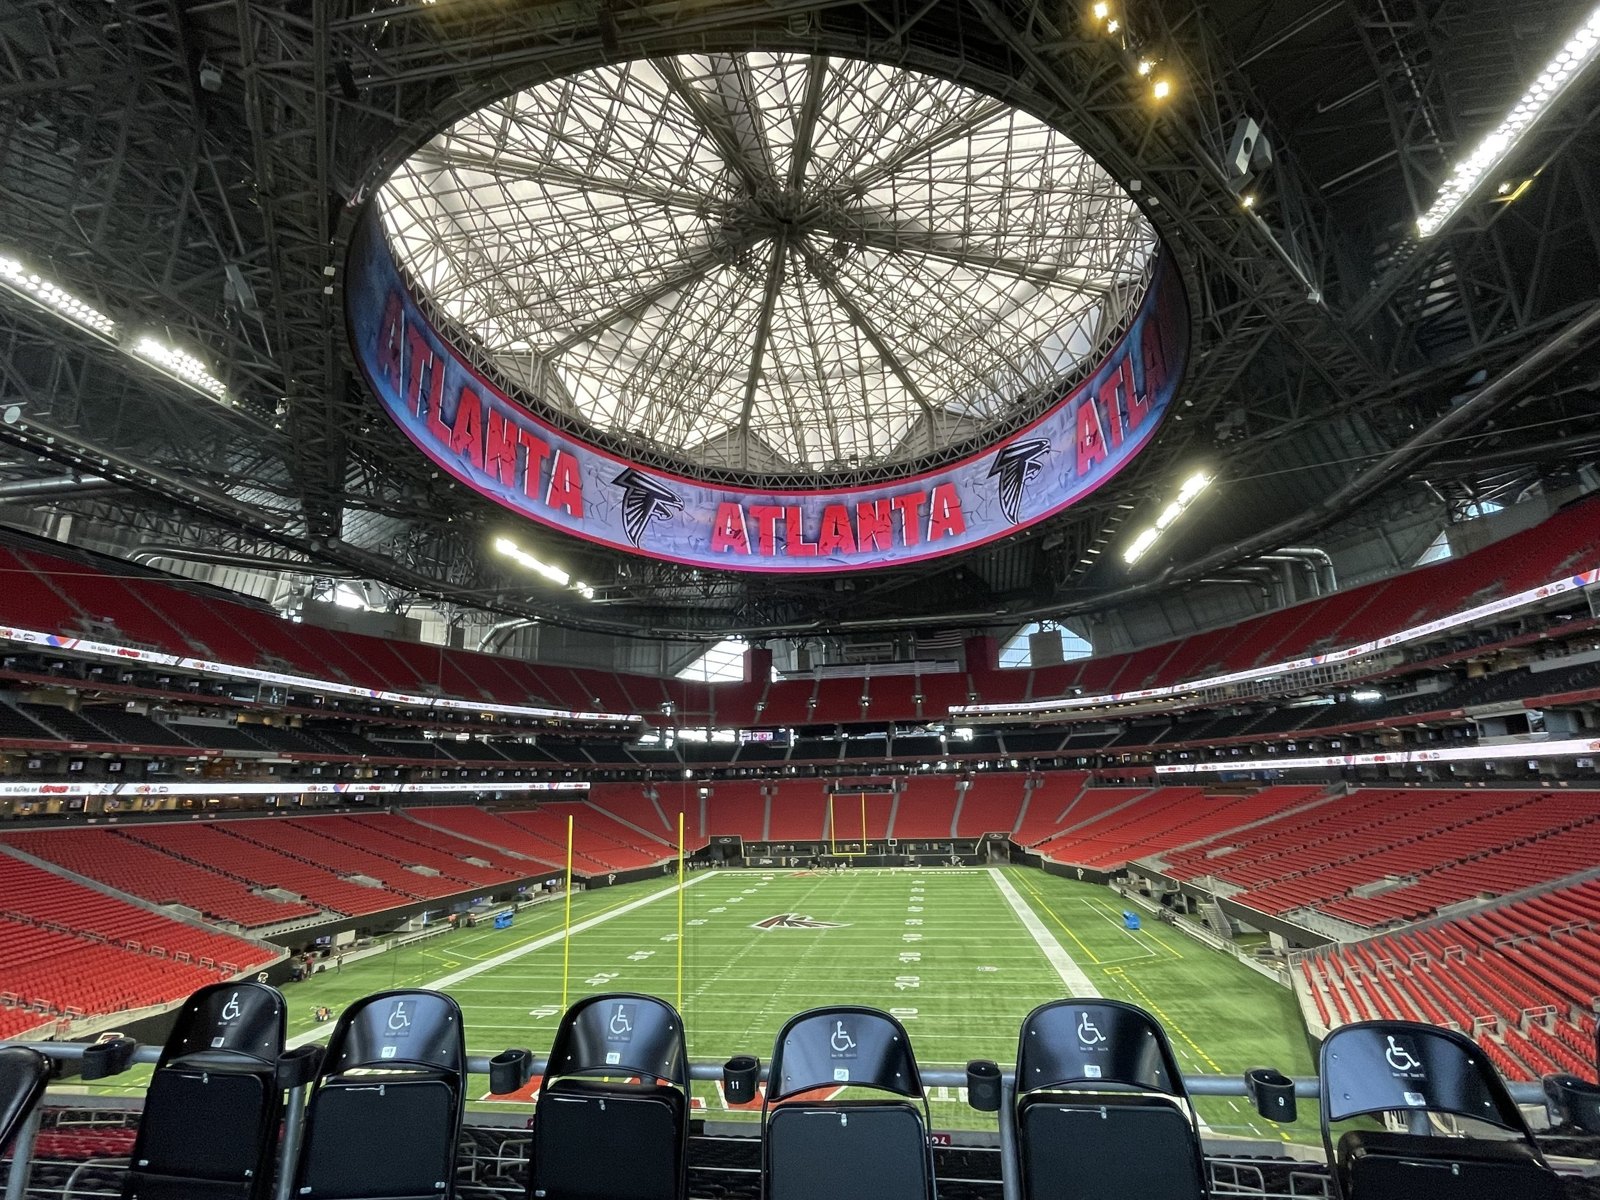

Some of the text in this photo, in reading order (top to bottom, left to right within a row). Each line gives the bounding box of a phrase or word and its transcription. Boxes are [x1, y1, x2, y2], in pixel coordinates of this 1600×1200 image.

[377, 288, 584, 519] ATLANTA
[710, 482, 967, 557] ATLANTA
[731, 1080, 740, 1090] 11
[1278, 1096, 1285, 1107] 9
